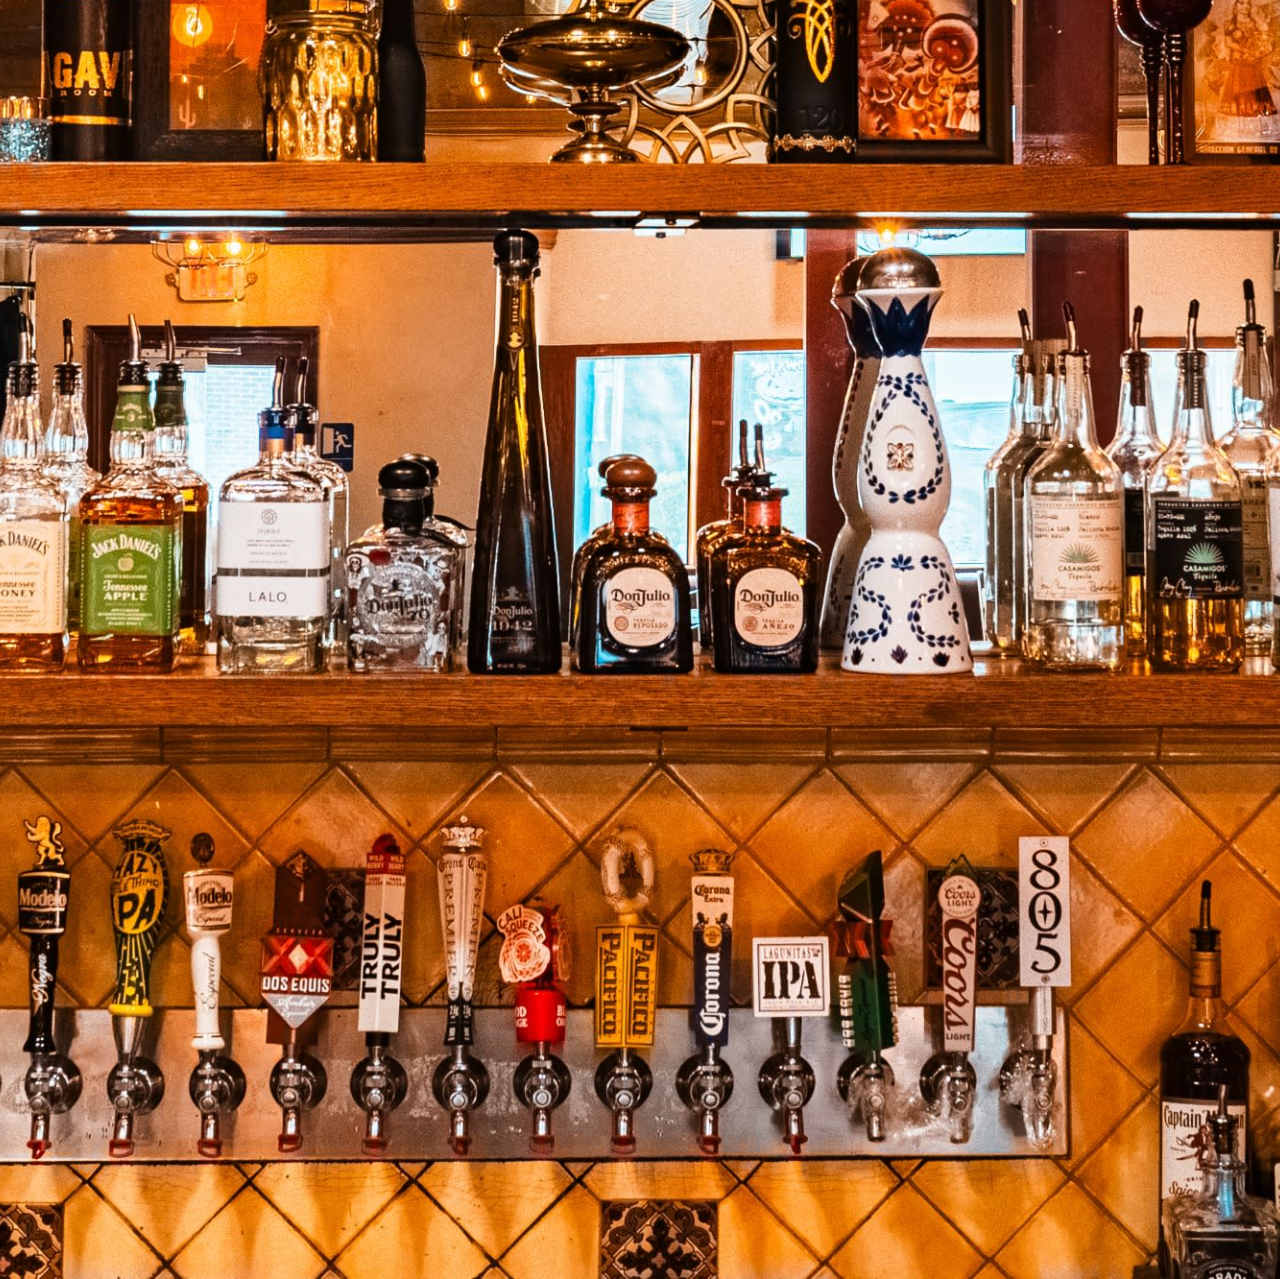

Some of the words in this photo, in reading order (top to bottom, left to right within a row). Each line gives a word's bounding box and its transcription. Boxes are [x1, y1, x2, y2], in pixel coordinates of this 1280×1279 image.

[91, 537, 118, 559] JACK
[1057, 564, 1101, 572] CASAMIGOS
[1182, 565, 1226, 573] CASAMIGOS
[103, 579, 148, 592] Tennessee
[103, 592, 148, 601] APPLE
[20, 887, 67, 907] Modelo
[187, 886, 233, 906] Modelo
[694, 884, 731, 895] Corona
[704, 895, 724, 903] Extra
[944, 888, 976, 900] Coors
[947, 899, 974, 907] LIGHT
[1028, 849, 1063, 974] 805
[499, 906, 524, 930] CALI
[505, 919, 544, 942] SQUEEZE
[361, 912, 381, 1000] TRULY
[380, 912, 402, 1000] TRULY
[763, 946, 812, 960] LAGUNITAS
[601, 932, 622, 1035] PACIFICO
[632, 933, 656, 1035] PACIFICO
[762, 960, 821, 999] IPA
[944, 917, 976, 1031] Coors
[262, 975, 289, 991] DOS
[290, 976, 330, 994] EQUIS
[700, 951, 727, 1037] Corona
[946, 1033, 971, 1041] LIGHT
[1163, 1104, 1201, 1130] Captain
